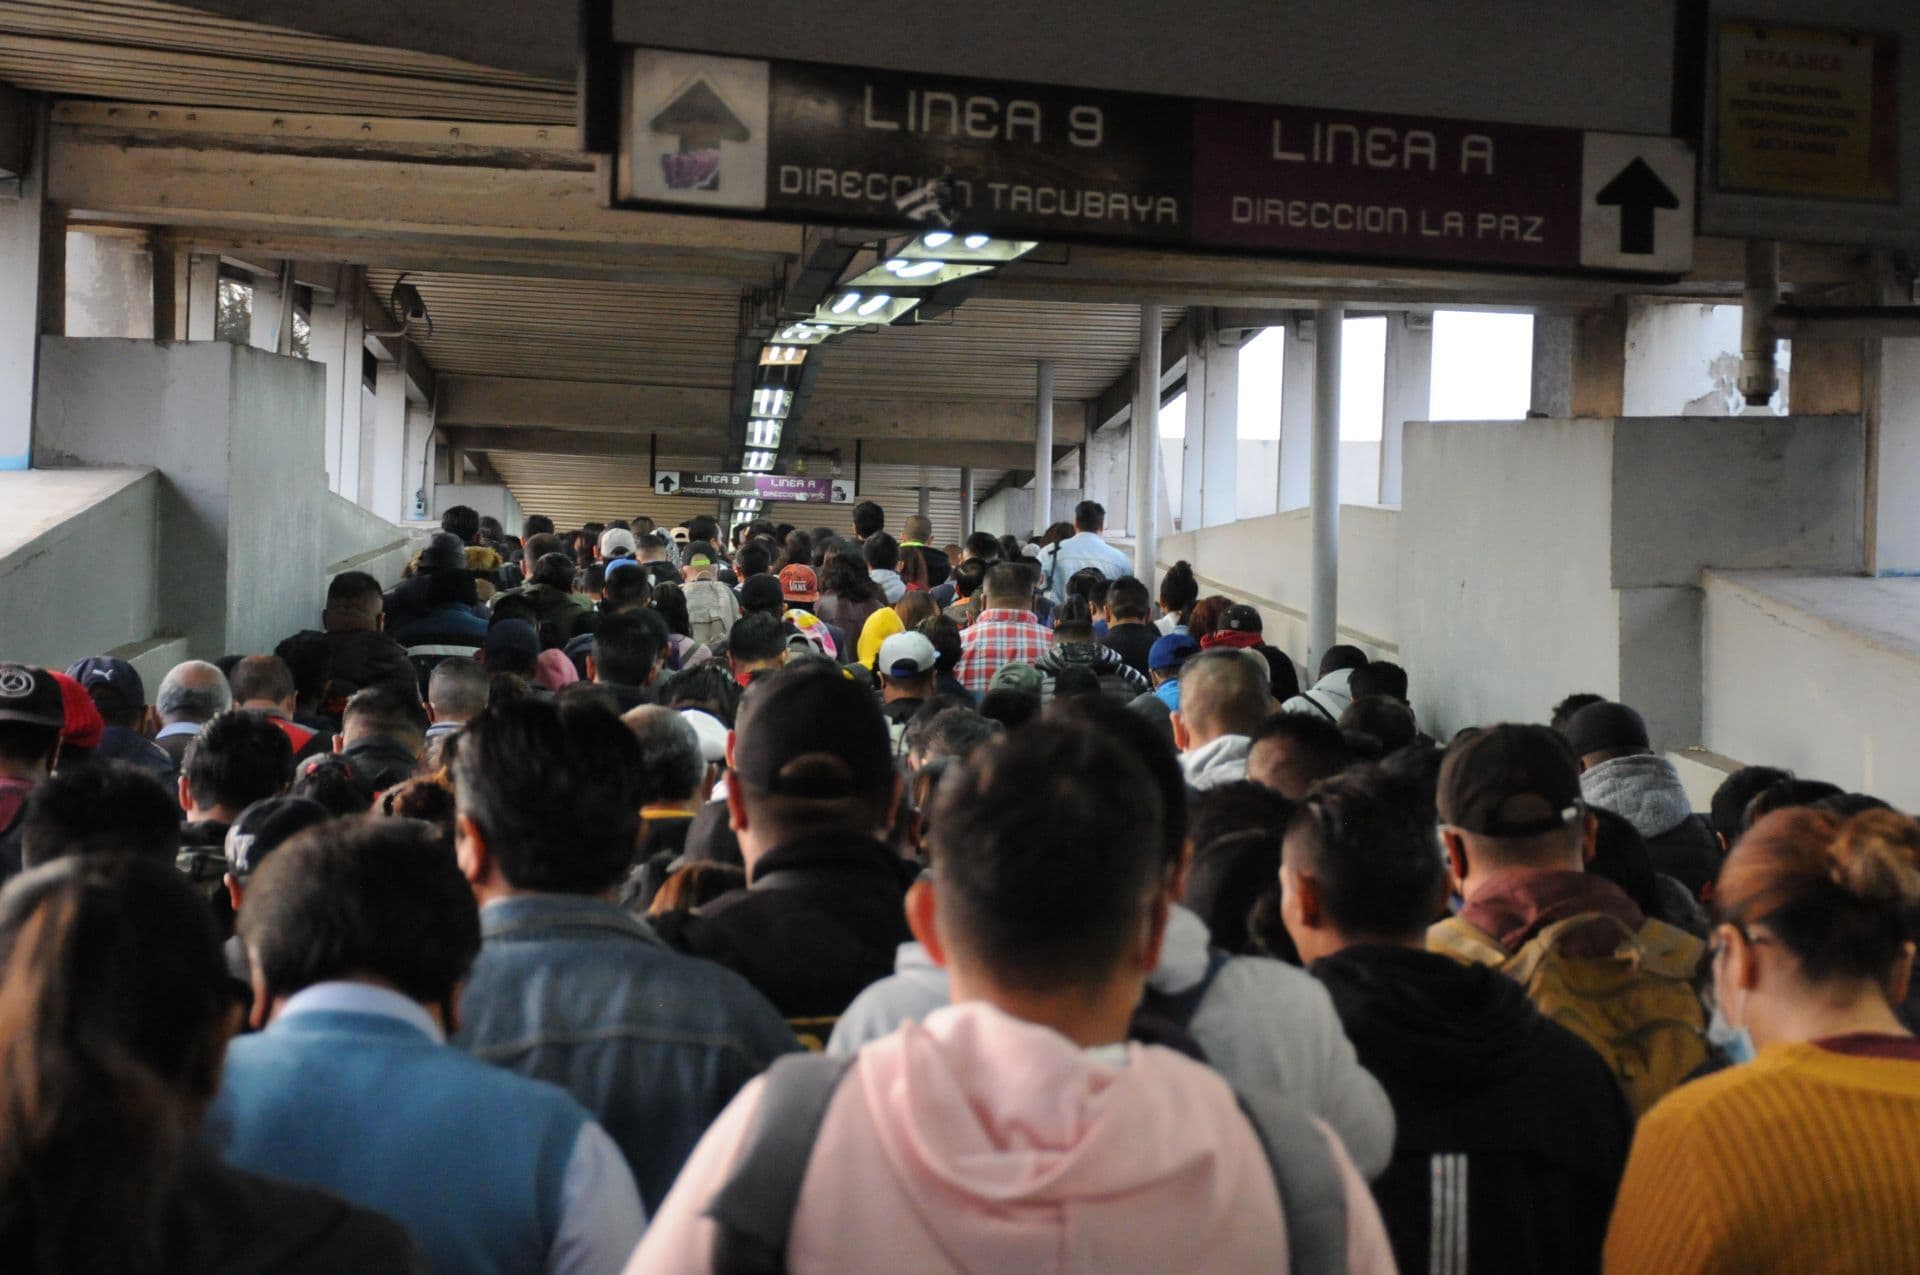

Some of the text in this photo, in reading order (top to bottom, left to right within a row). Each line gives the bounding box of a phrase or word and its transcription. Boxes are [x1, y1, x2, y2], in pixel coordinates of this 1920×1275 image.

[863, 85, 1104, 148] LINEA 9
[1271, 118, 1494, 175] LINEA A
[779, 165, 1179, 224] DIRECCN TACUBAYA
[1231, 197, 1545, 243] DIRECCION LA PAZ
[694, 474, 729, 484] LINEA
[770, 479, 816, 488] LINEA A
[789, 580, 807, 592] VANS
